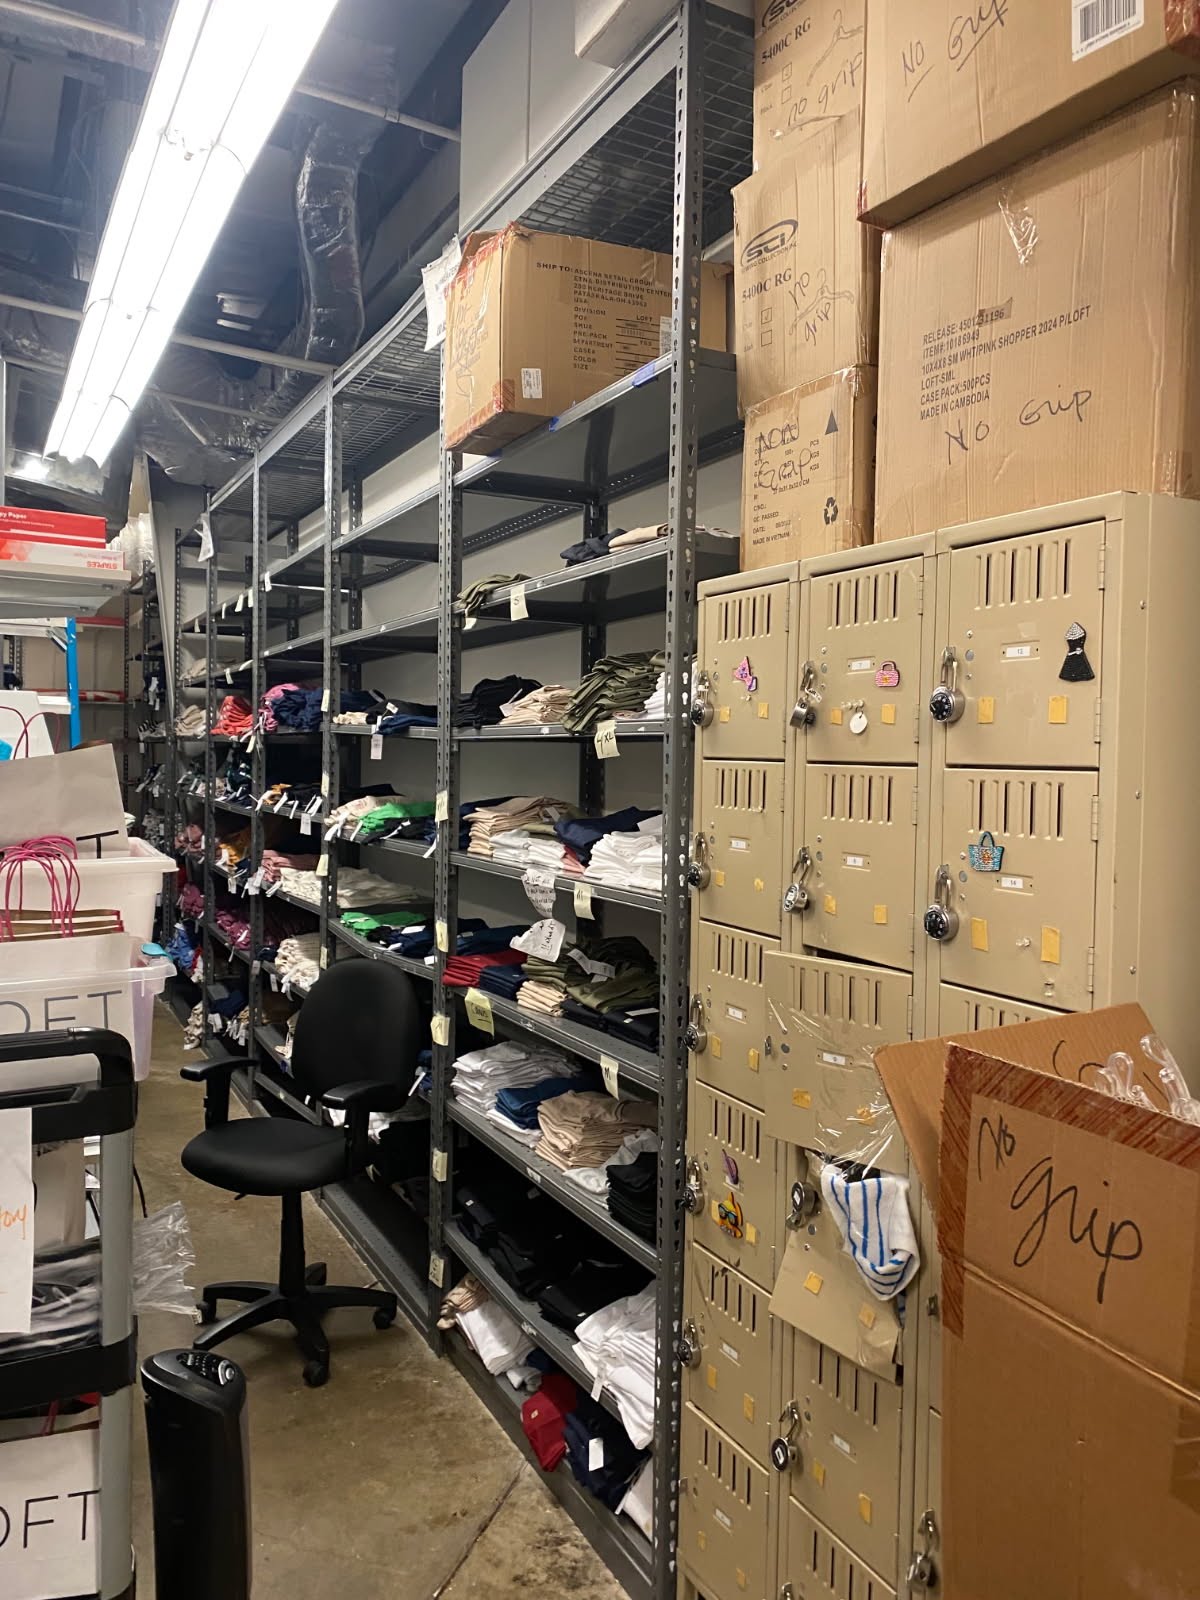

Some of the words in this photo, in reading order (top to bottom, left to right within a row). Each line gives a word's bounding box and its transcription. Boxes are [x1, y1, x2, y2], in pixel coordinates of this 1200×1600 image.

[795, 17, 811, 40] RG
[902, 40, 924, 87] NO
[536, 262, 557, 270] SHIP
[775, 268, 792, 287] RG
[574, 306, 606, 316] DIVISION
[636, 314, 653, 322] LOFT
[923, 323, 958, 346] RELEASE:
[947, 352, 959, 367] SM
[960, 339, 997, 362] WHT/PINK
[998, 325, 1037, 349] SHOPPER
[1038, 317, 1057, 335] 2024
[1059, 304, 1091, 328] P/LOFT
[920, 389, 940, 406] CASE
[920, 405, 940, 421] MADE
[940, 401, 949, 415] IN
[949, 389, 990, 411] CAMBODIA
[1010, 1157, 1143, 1304] grip
